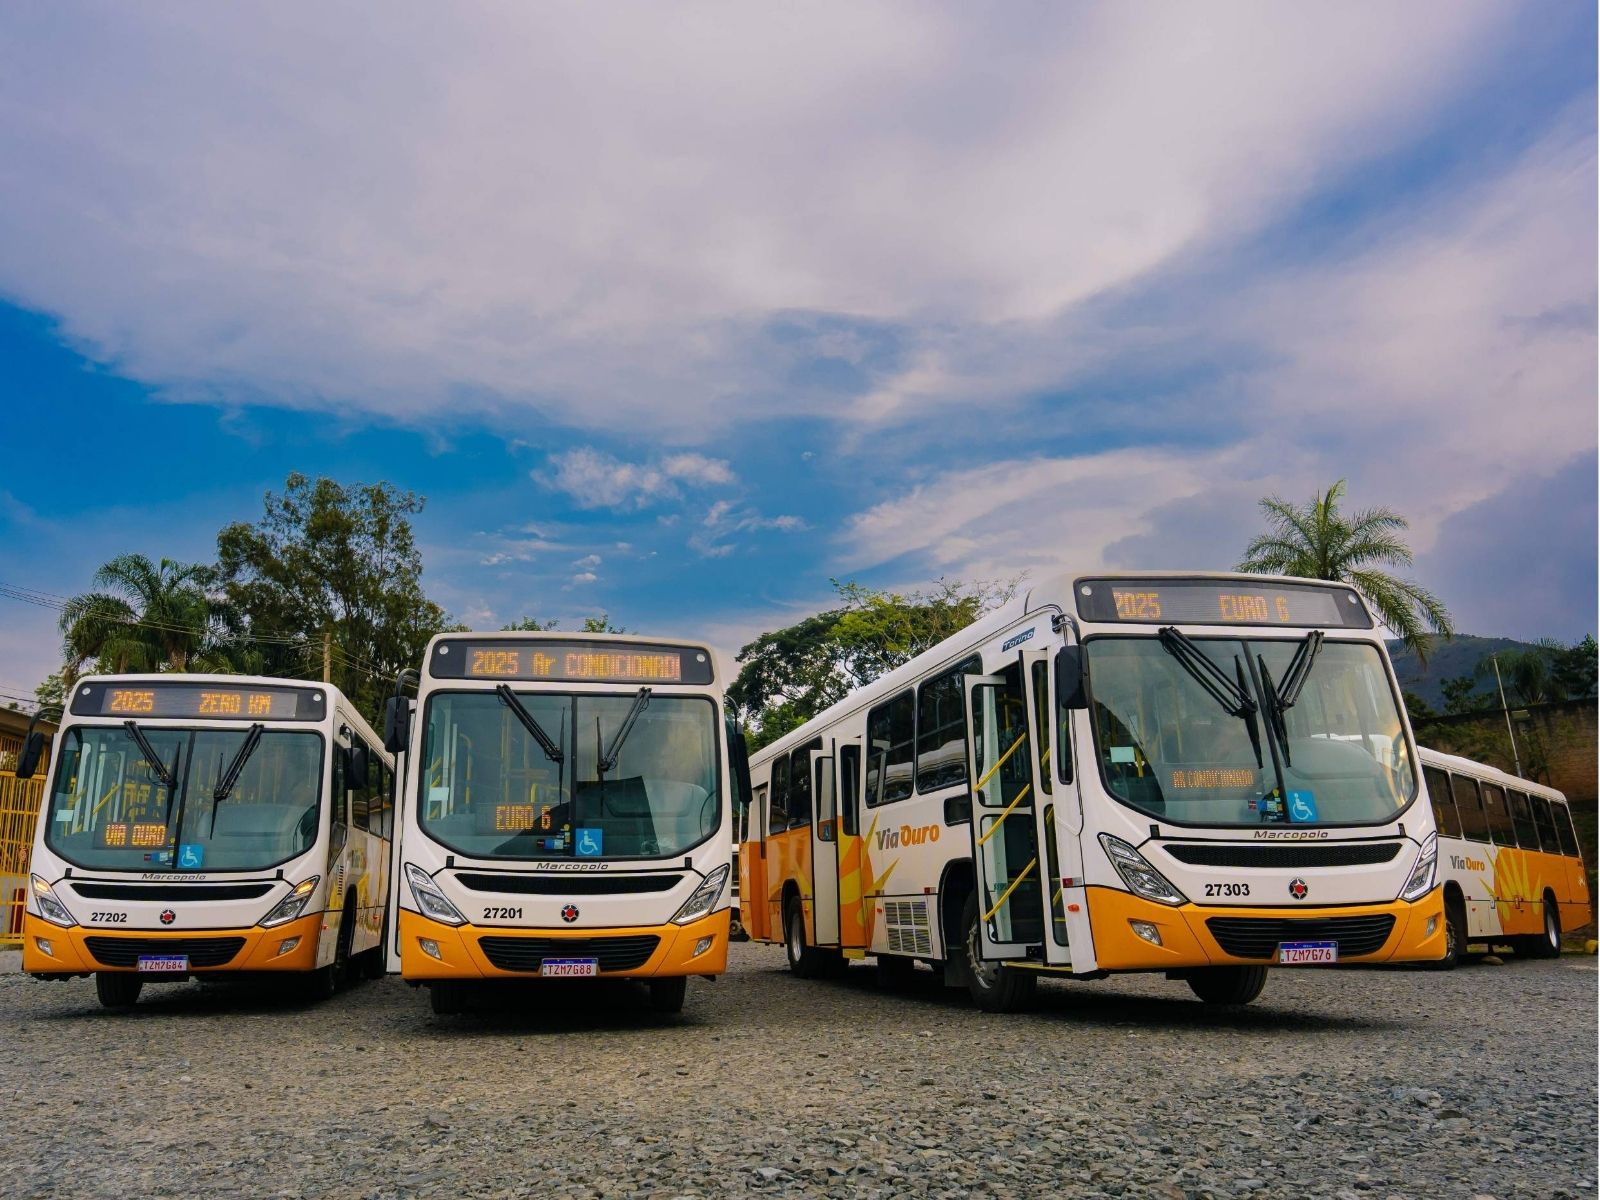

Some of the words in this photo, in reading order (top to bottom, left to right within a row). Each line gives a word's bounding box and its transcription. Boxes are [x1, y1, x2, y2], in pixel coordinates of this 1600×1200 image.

[1219, 595, 1268, 621] EURO
[1274, 596, 1290, 622] 6
[1003, 631, 1034, 651] Torino
[472, 650, 519, 676] 2025
[532, 652, 556, 676] Ar
[565, 653, 680, 678] CONDICIONAD
[110, 690, 154, 713] 2025
[199, 693, 241, 713] ZERO
[247, 694, 272, 715] KM
[495, 805, 534, 830] EURO
[541, 805, 551, 830] 6
[105, 824, 127, 846] VIA
[131, 824, 167, 846] OURO
[1253, 830, 1329, 840] Marcopolo
[536, 862, 609, 872] Marcopolo
[141, 873, 207, 881] Marcopolo
[1204, 883, 1251, 897] 27303
[90, 912, 128, 923] 27202
[483, 907, 523, 919] 27201
[1284, 949, 1332, 962] TZM7G76
[143, 961, 183, 970] TZM7G84
[547, 964, 593, 975] TZM7G88
